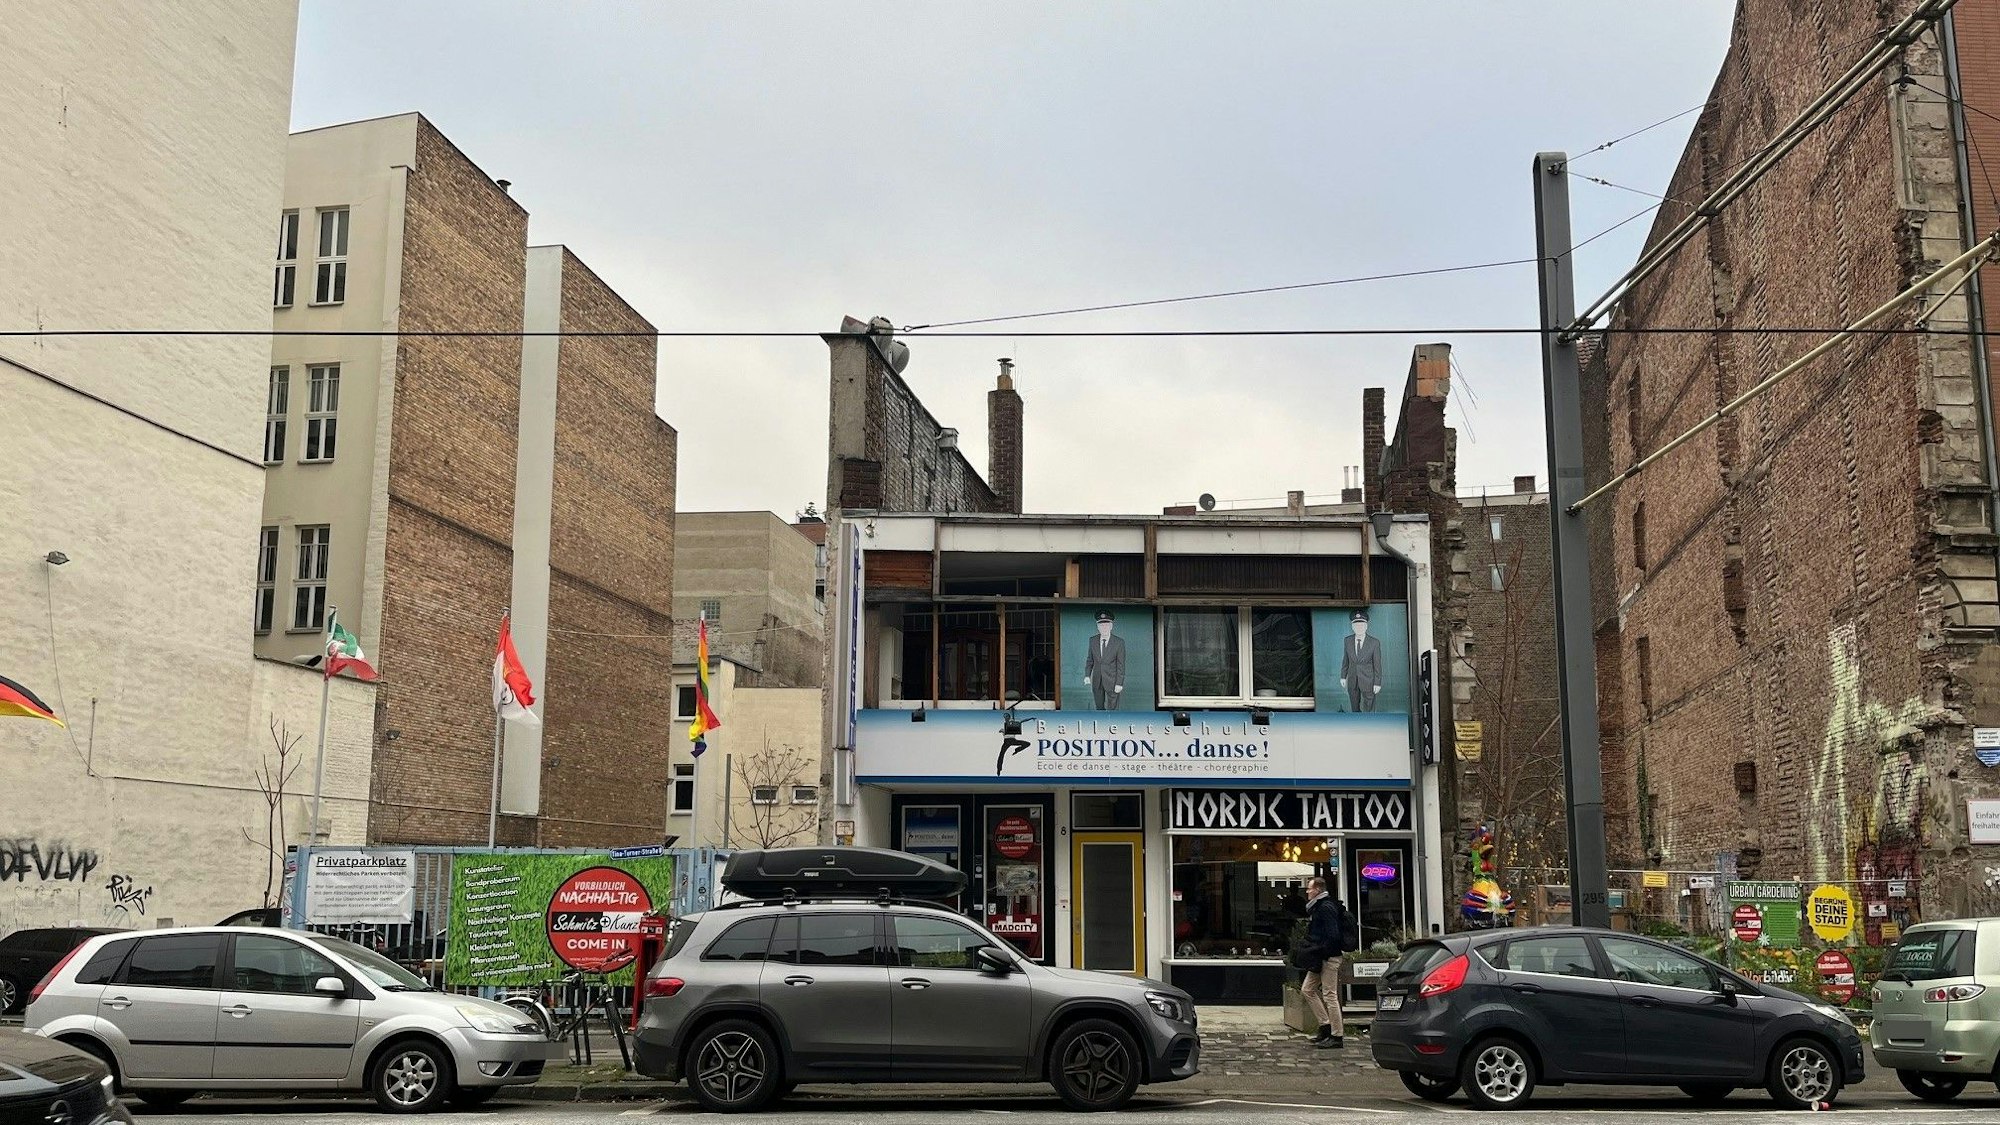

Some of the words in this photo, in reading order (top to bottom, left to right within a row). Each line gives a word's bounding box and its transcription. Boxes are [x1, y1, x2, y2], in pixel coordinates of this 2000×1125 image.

[1036, 720, 1268, 736] Ballettschule
[1038, 738, 1179, 757] POSITION...
[1037, 762, 1064, 770] Ecole
[1066, 762, 1079, 770] de
[1082, 762, 1110, 770] danse
[1122, 762, 1146, 774] stage
[1158, 762, 1193, 772] théâtre
[1204, 762, 1268, 774] chorégraphie
[1176, 792, 1284, 828] NORDIC
[1296, 793, 1405, 829] TATTOO
[1061, 826, 1066, 836] 8
[316, 856, 406, 868] Privatparkplatz
[1362, 866, 1395, 876] OPEN
[466, 876, 520, 888] Bandproberaum
[575, 882, 625, 891] VORBILDLICH
[466, 889, 518, 900] Konzertlocation
[1729, 885, 1755, 898] URBAN
[1758, 886, 1799, 899] GARDENING
[560, 892, 639, 905] NACHHALTIG
[1583, 892, 1605, 904] 295
[1814, 897, 1847, 906] BEGRÜNE
[467, 902, 512, 913] Lesungsraum
[1815, 905, 1848, 915] DEINE
[510, 912, 541, 921] Konzepte
[553, 914, 599, 930] Schmitz
[610, 914, 640, 930] Kunz
[1815, 915, 1848, 925] STADT
[469, 927, 509, 938] Tauschregal
[995, 924, 1033, 933] MADCITY
[470, 940, 514, 952] Kleidertausch
[567, 939, 608, 949] COME
[612, 939, 625, 949] IN
[470, 952, 520, 964] Pflanzentausch
[534, 961, 552, 970] mehr
